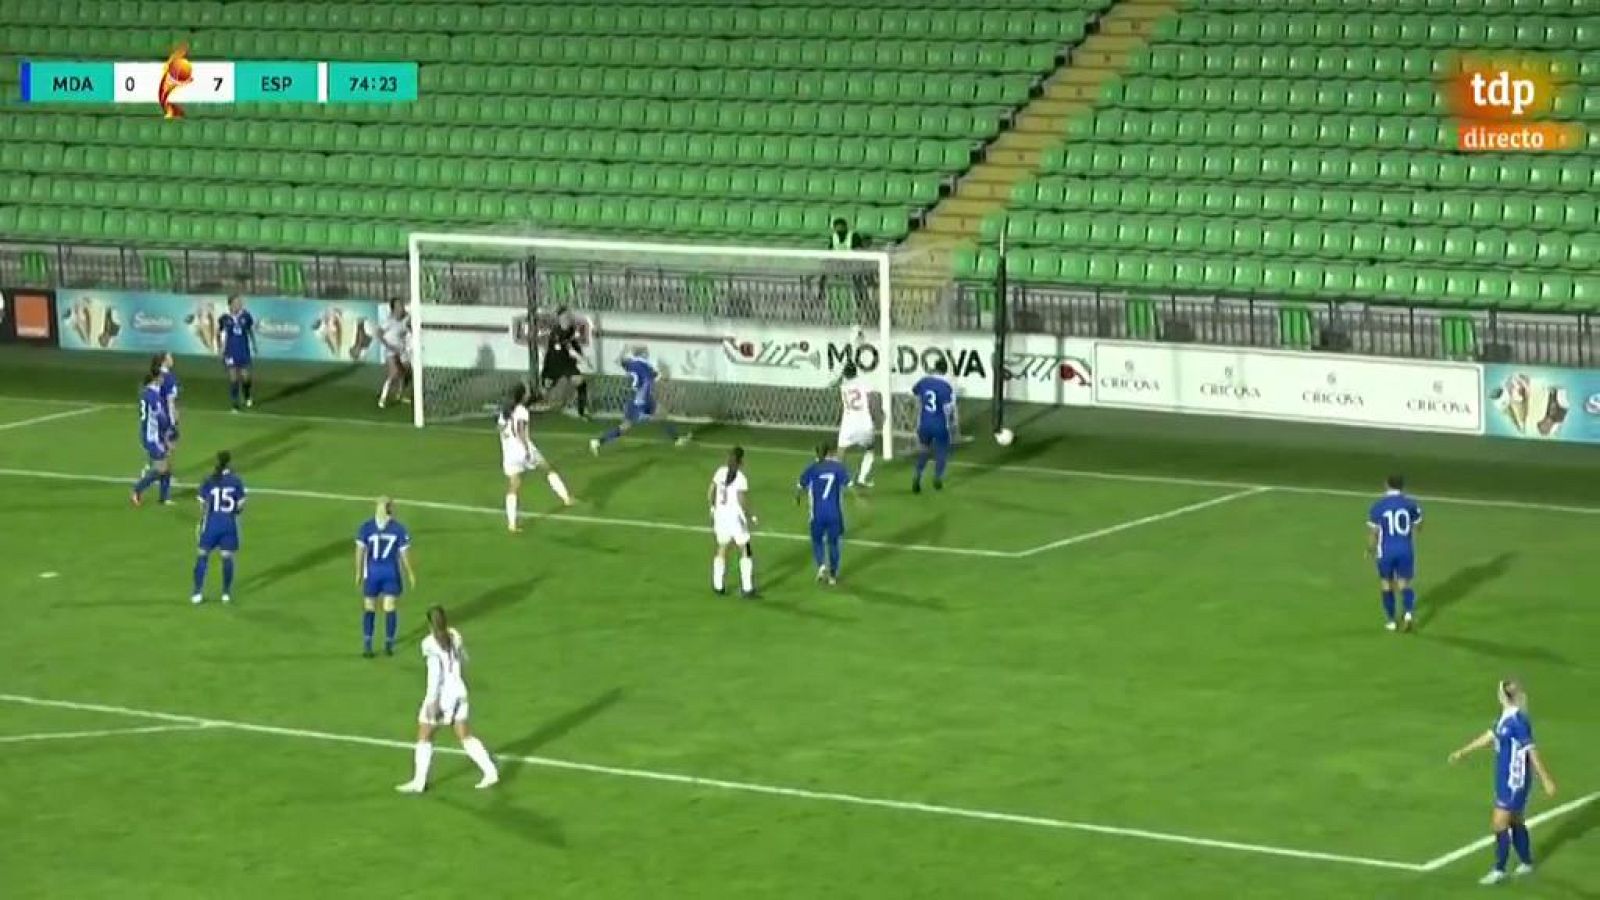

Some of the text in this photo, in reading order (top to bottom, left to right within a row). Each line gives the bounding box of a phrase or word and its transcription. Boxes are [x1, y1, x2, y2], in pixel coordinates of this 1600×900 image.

[826, 341, 987, 379] MODOVA
[924, 389, 938, 413] 3
[209, 486, 236, 514] 15
[818, 471, 836, 501] 7
[1381, 507, 1411, 537] 10
[367, 533, 398, 560] 17
